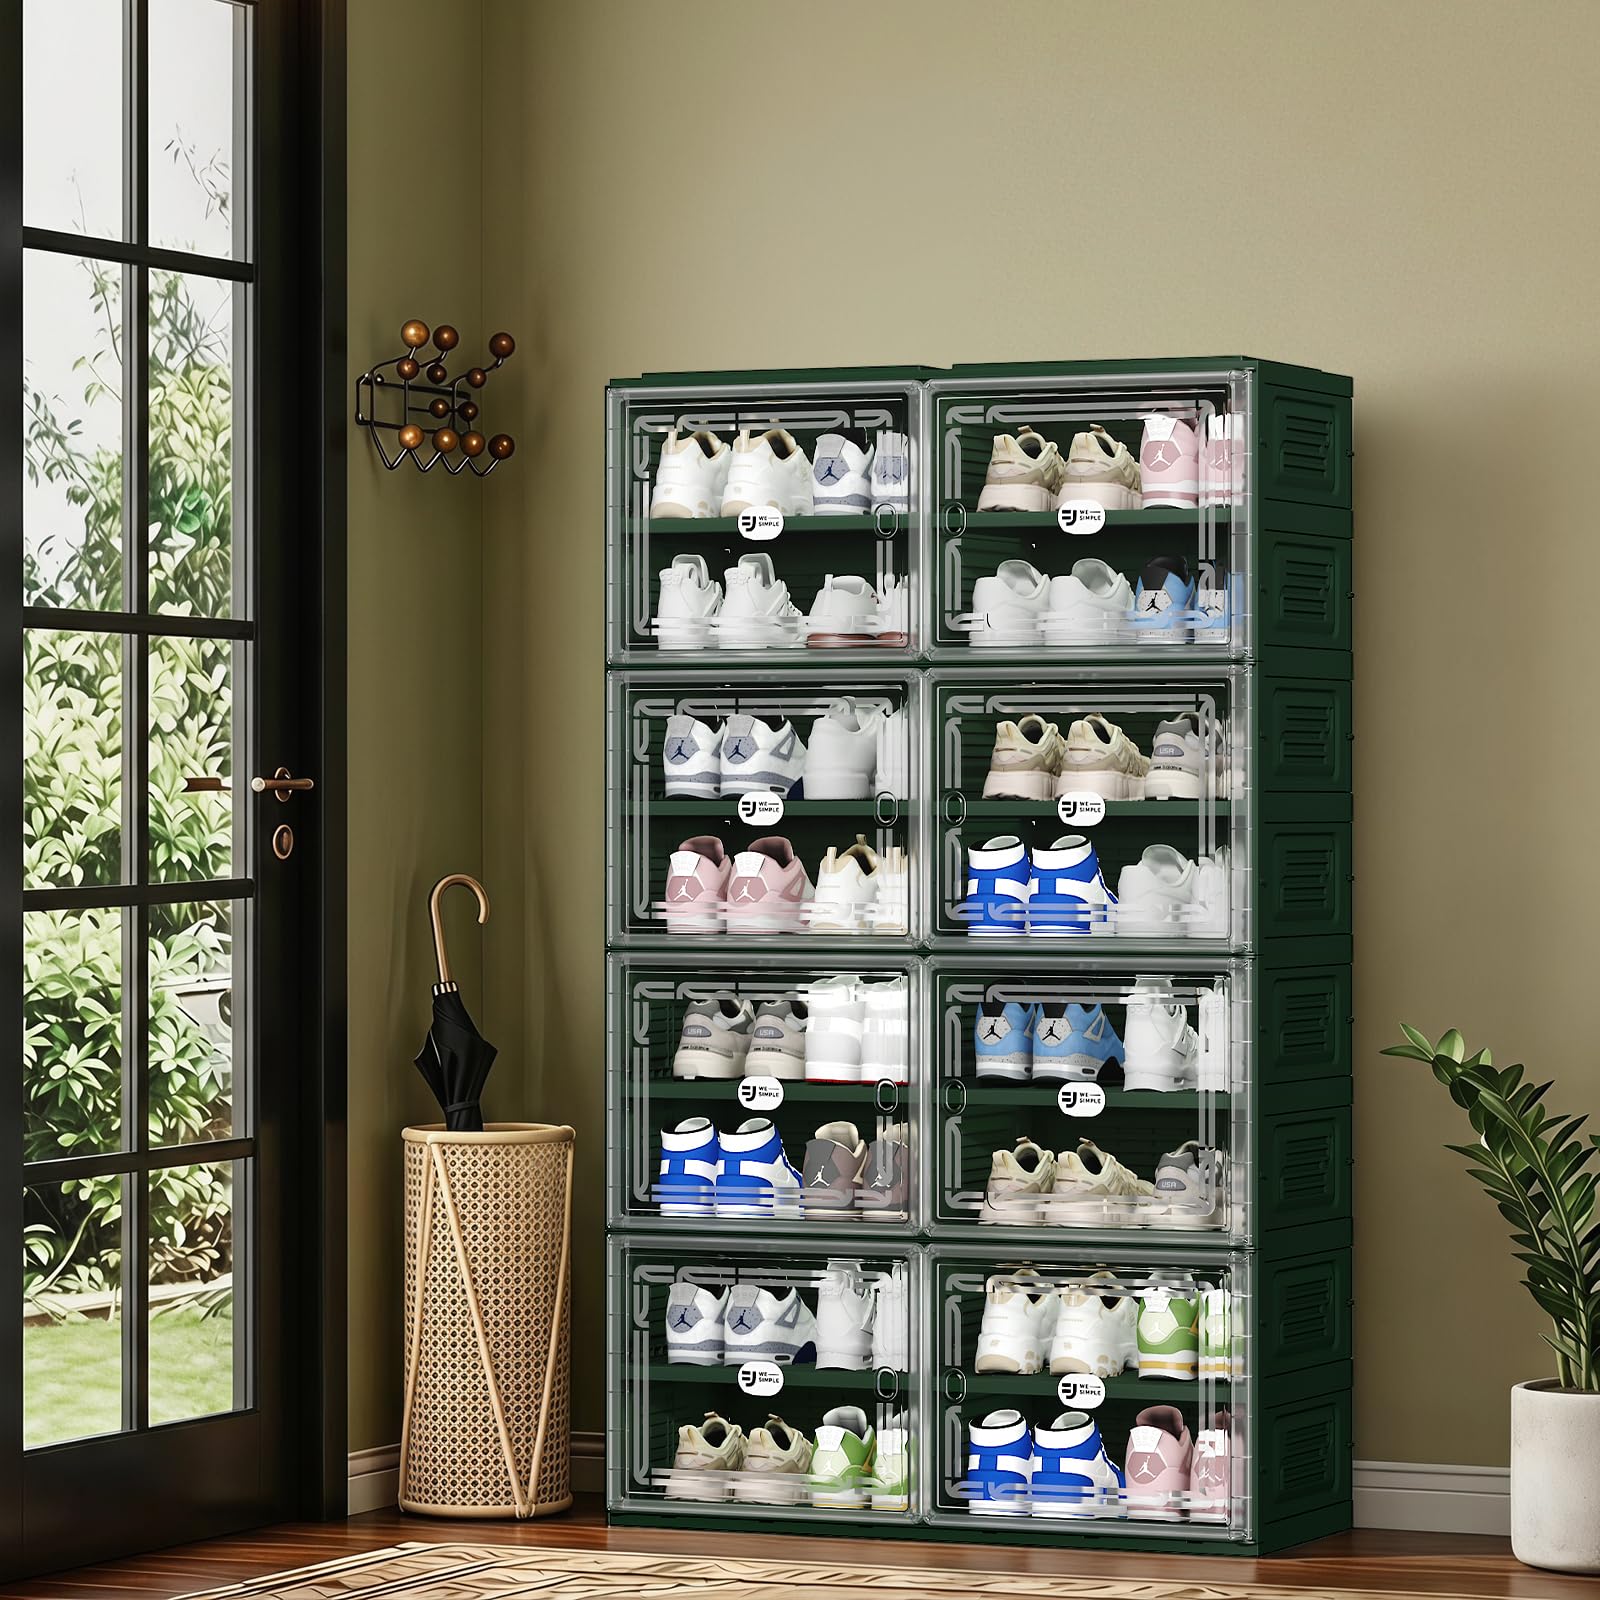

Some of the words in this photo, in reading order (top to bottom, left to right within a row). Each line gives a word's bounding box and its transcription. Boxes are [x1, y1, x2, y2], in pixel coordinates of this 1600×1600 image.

[1079, 806, 1101, 814] SIMPLE
[1079, 1097, 1101, 1105] SIMPLE
[1161, 1181, 1178, 1189] USA
